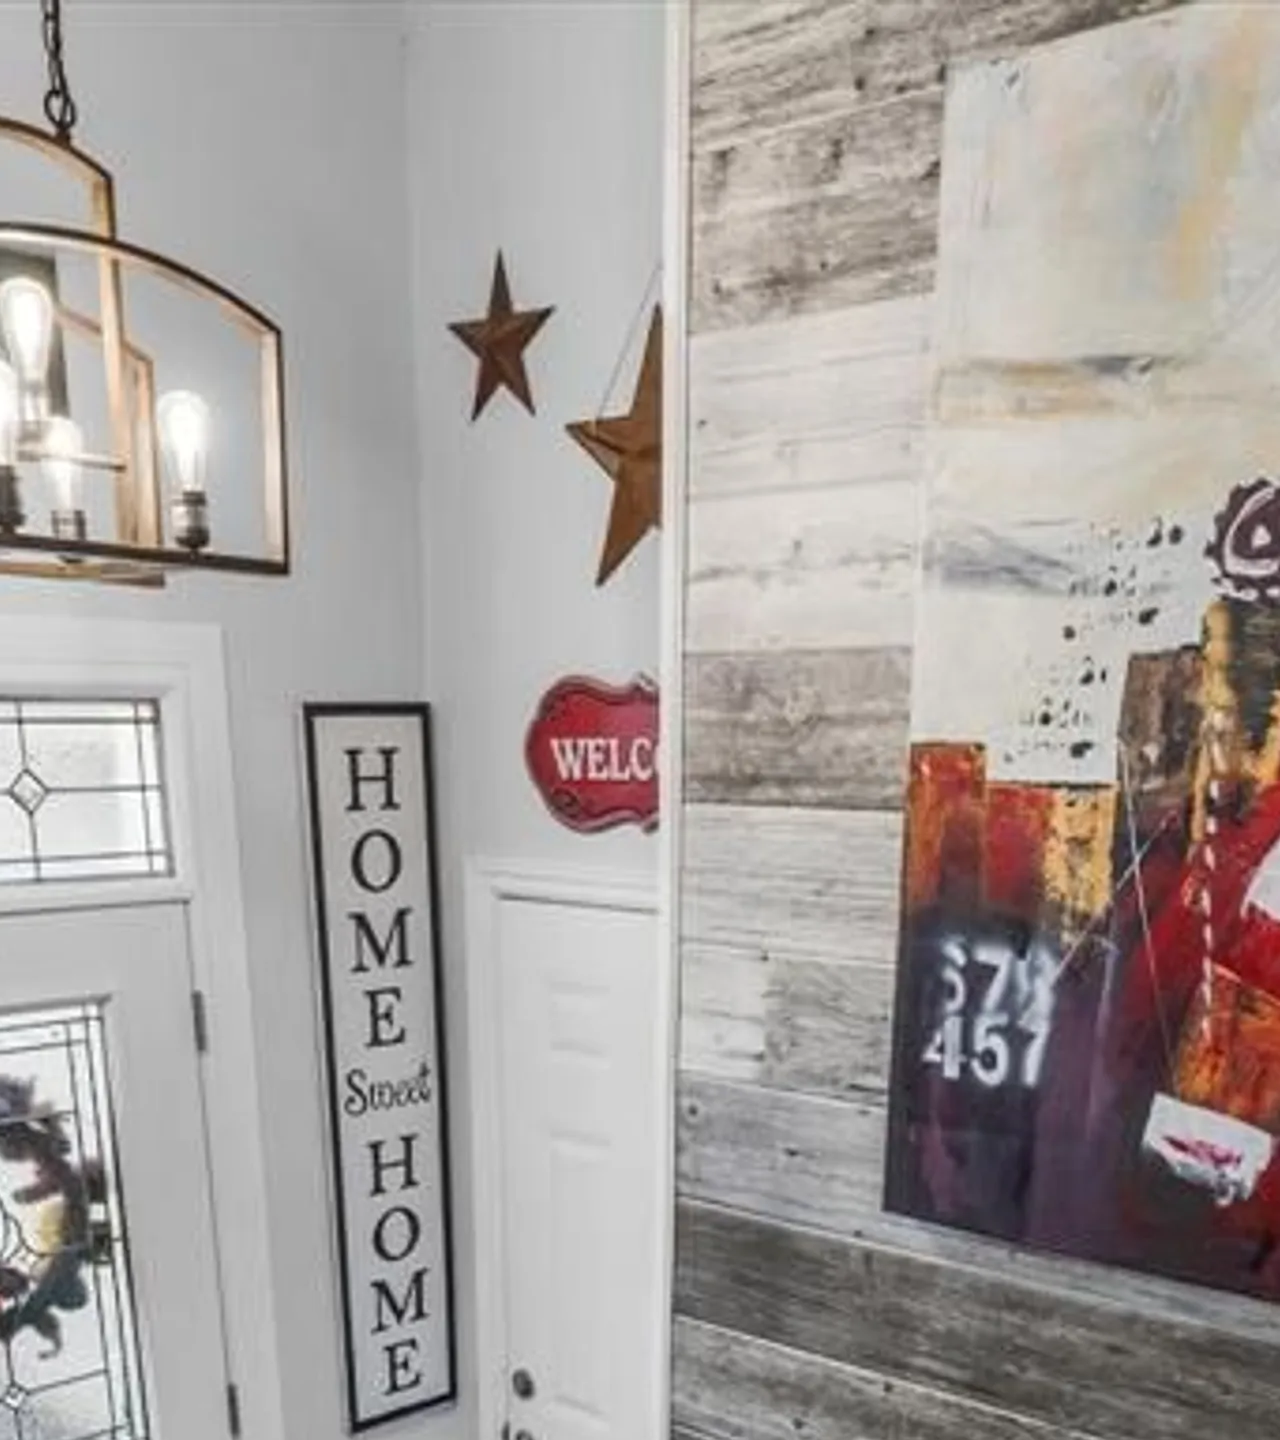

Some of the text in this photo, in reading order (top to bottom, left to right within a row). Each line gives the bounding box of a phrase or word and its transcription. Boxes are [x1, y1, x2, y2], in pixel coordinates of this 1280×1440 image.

[548, 736, 658, 782] WELC
[344, 747, 432, 1398] HOME Sweet HOME
